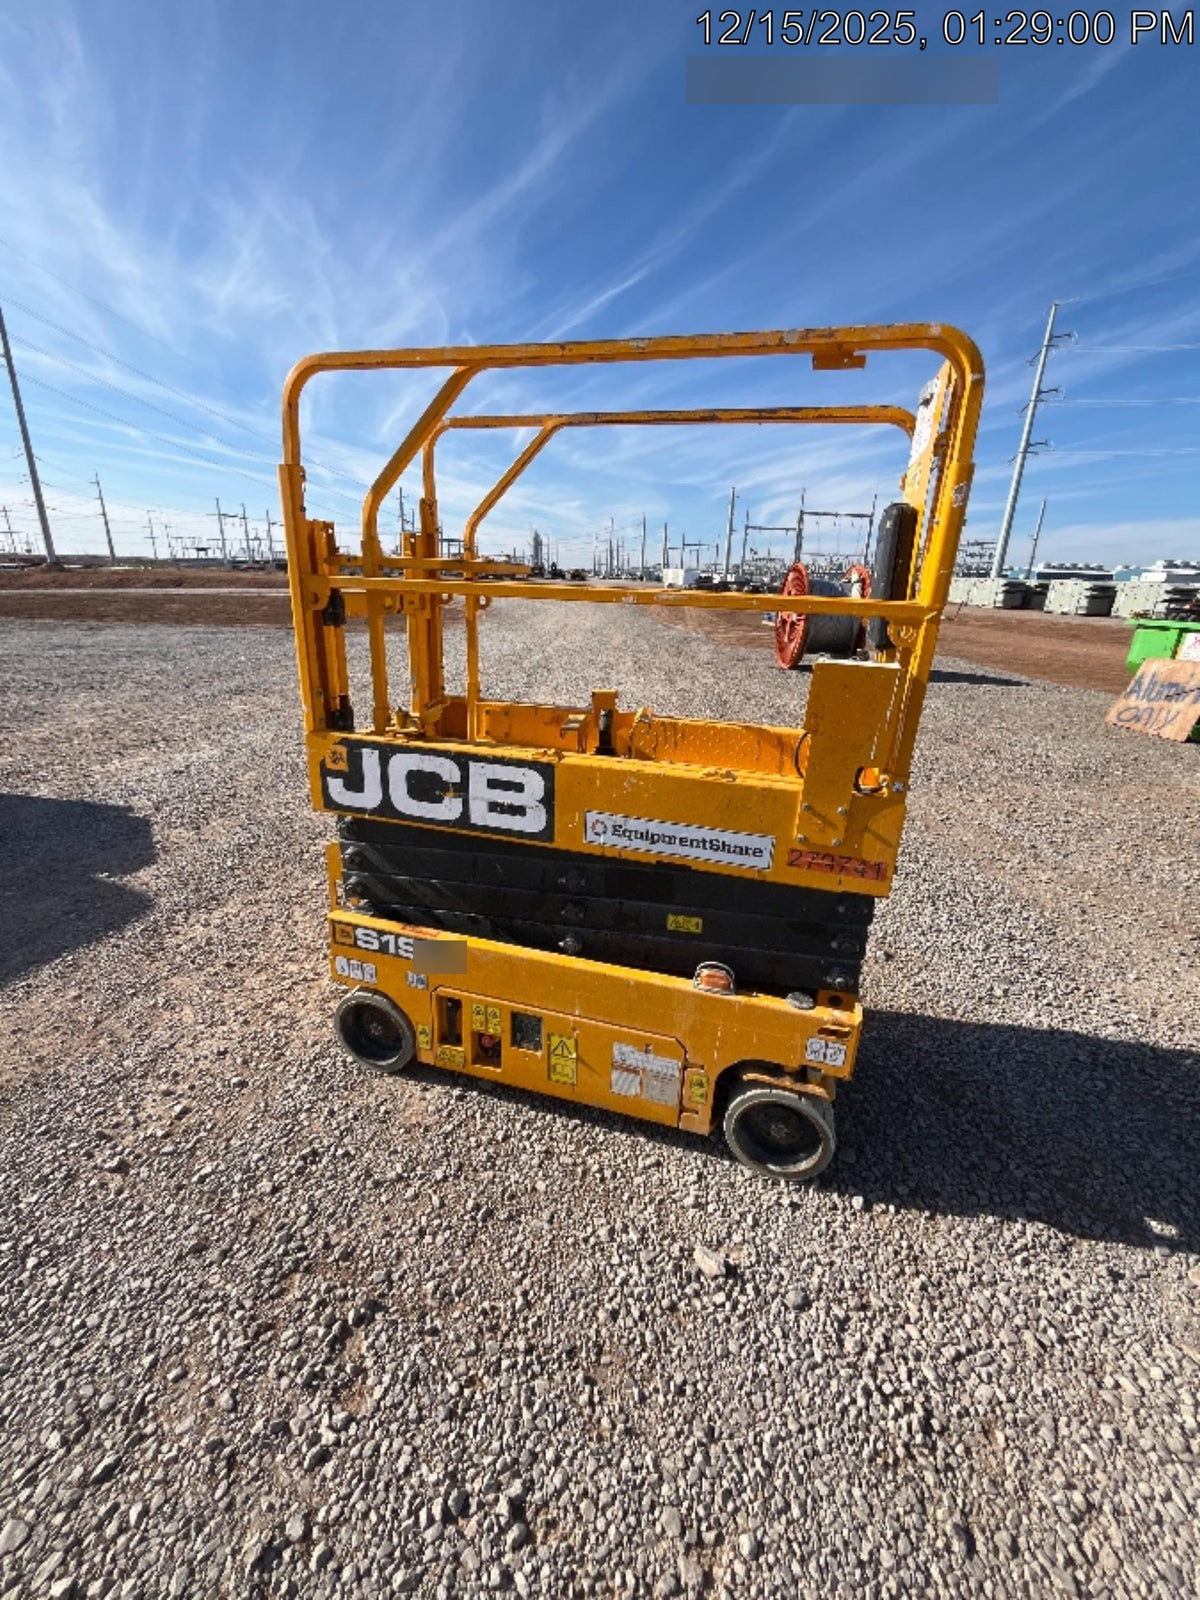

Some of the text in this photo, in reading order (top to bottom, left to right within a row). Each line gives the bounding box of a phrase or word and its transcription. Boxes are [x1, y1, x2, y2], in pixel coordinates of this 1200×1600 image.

[1122, 672, 1200, 704] Alum
[327, 747, 547, 833] JCB
[611, 823, 764, 859] EquipmentShare
